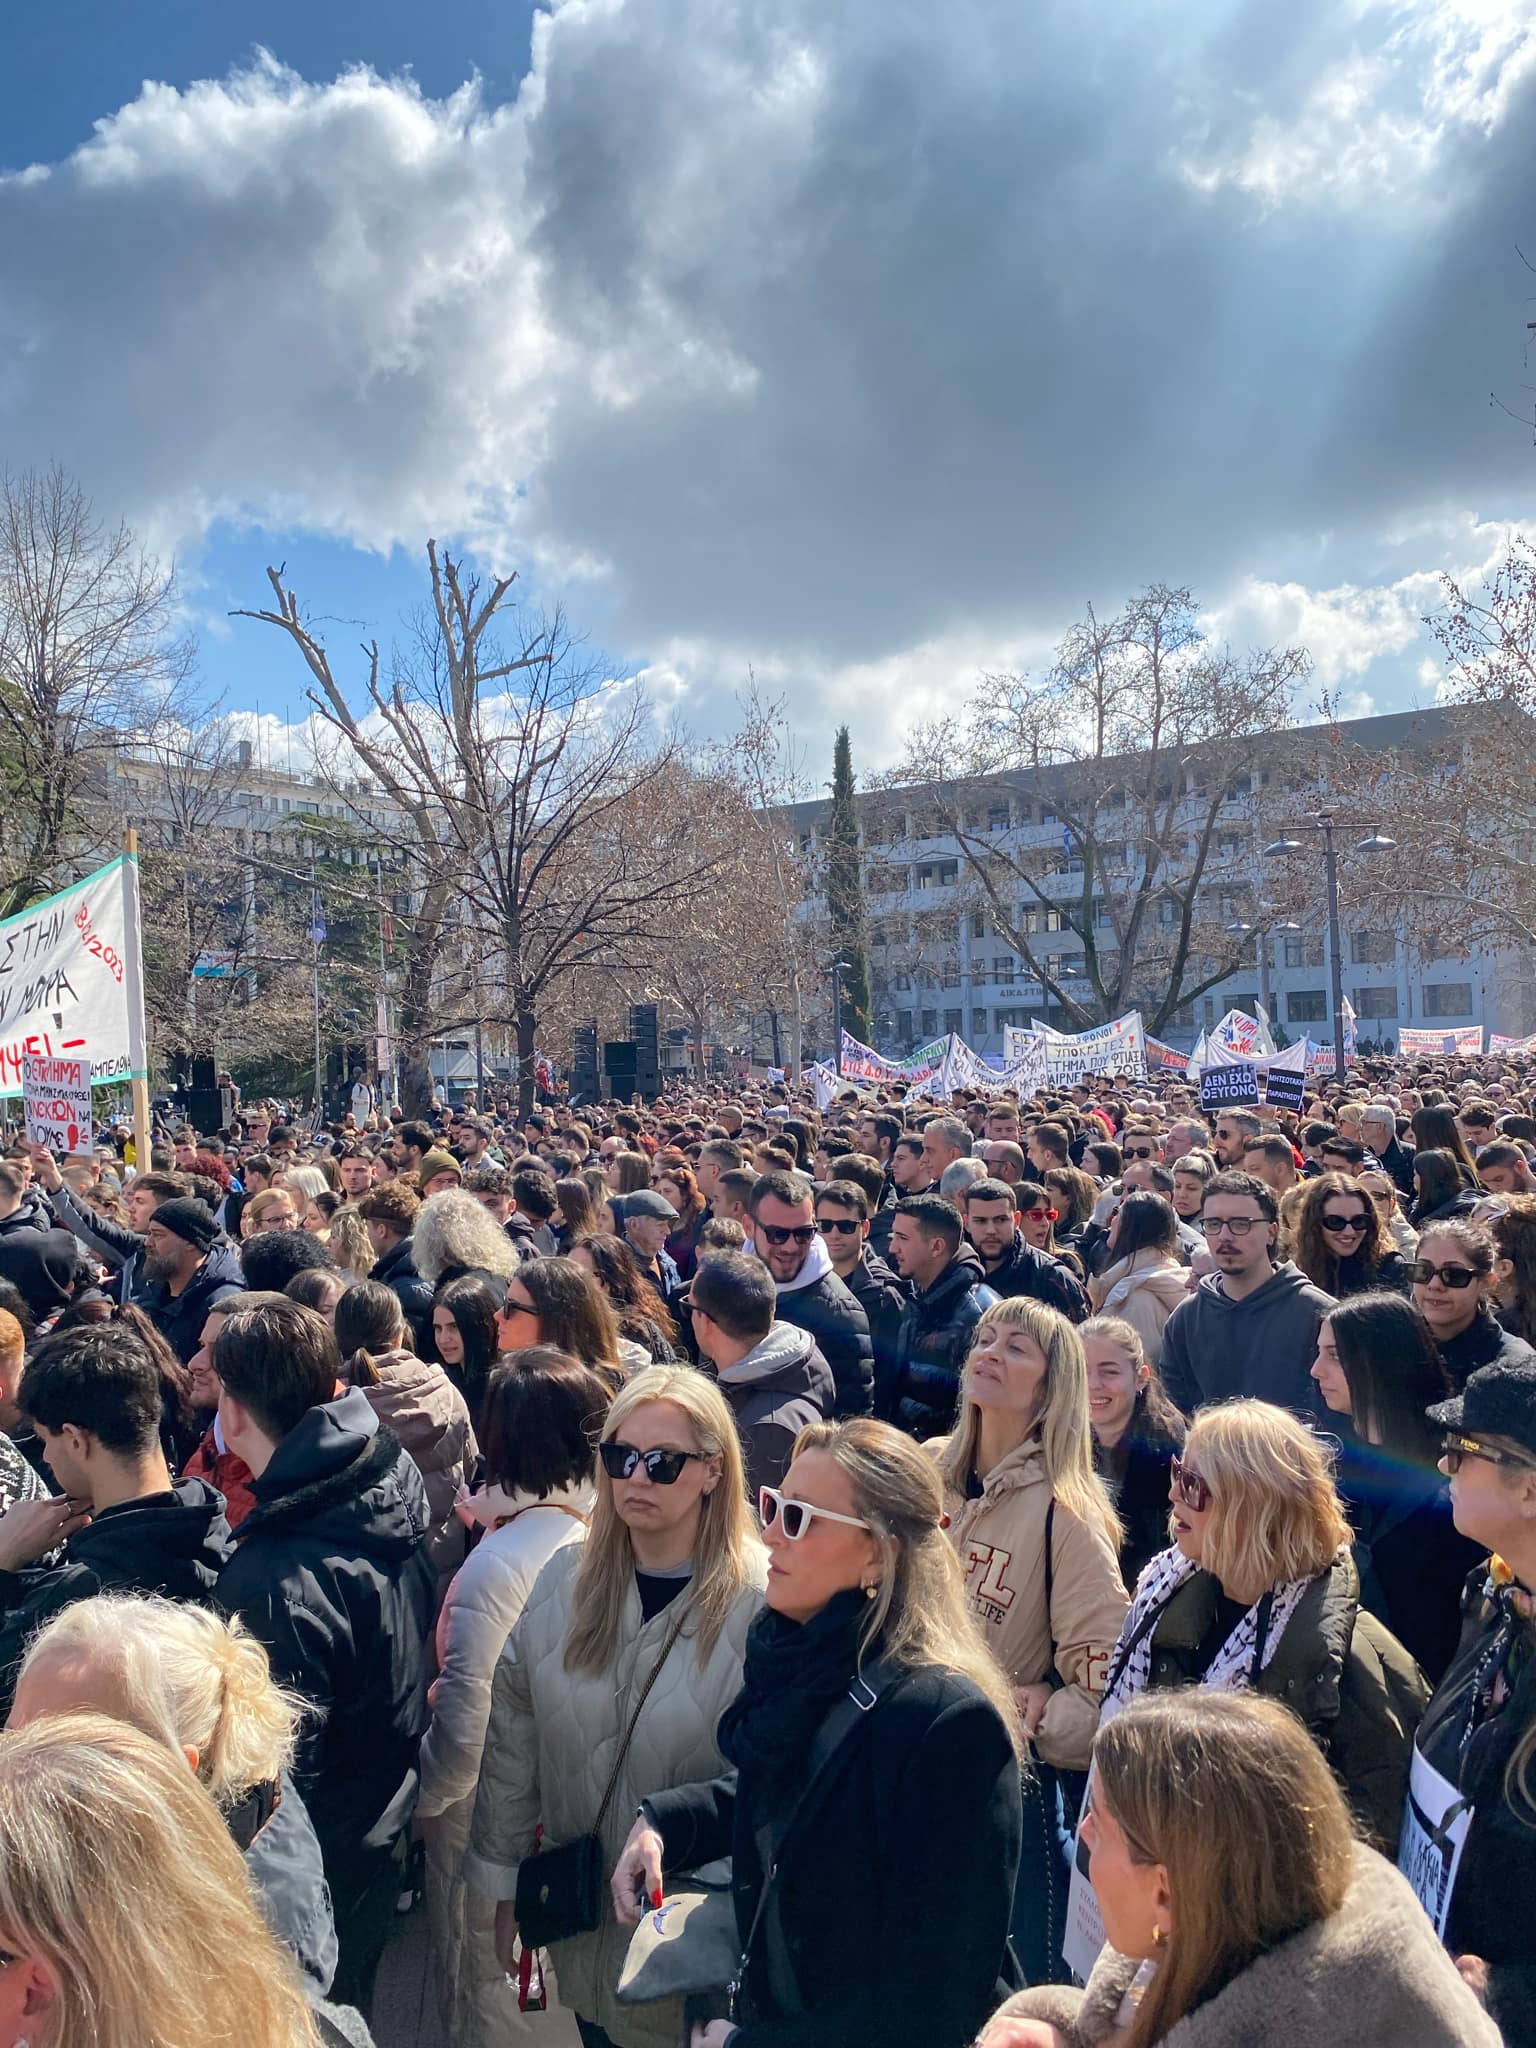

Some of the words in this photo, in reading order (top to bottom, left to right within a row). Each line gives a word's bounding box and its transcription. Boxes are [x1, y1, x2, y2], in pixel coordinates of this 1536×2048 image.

[1204, 1074, 1226, 1087] ΔΕΝ
[1229, 1072, 1252, 1085] ΕΧΩ
[1203, 1084, 1257, 1099] ΟΞΥΓΟΝΟ
